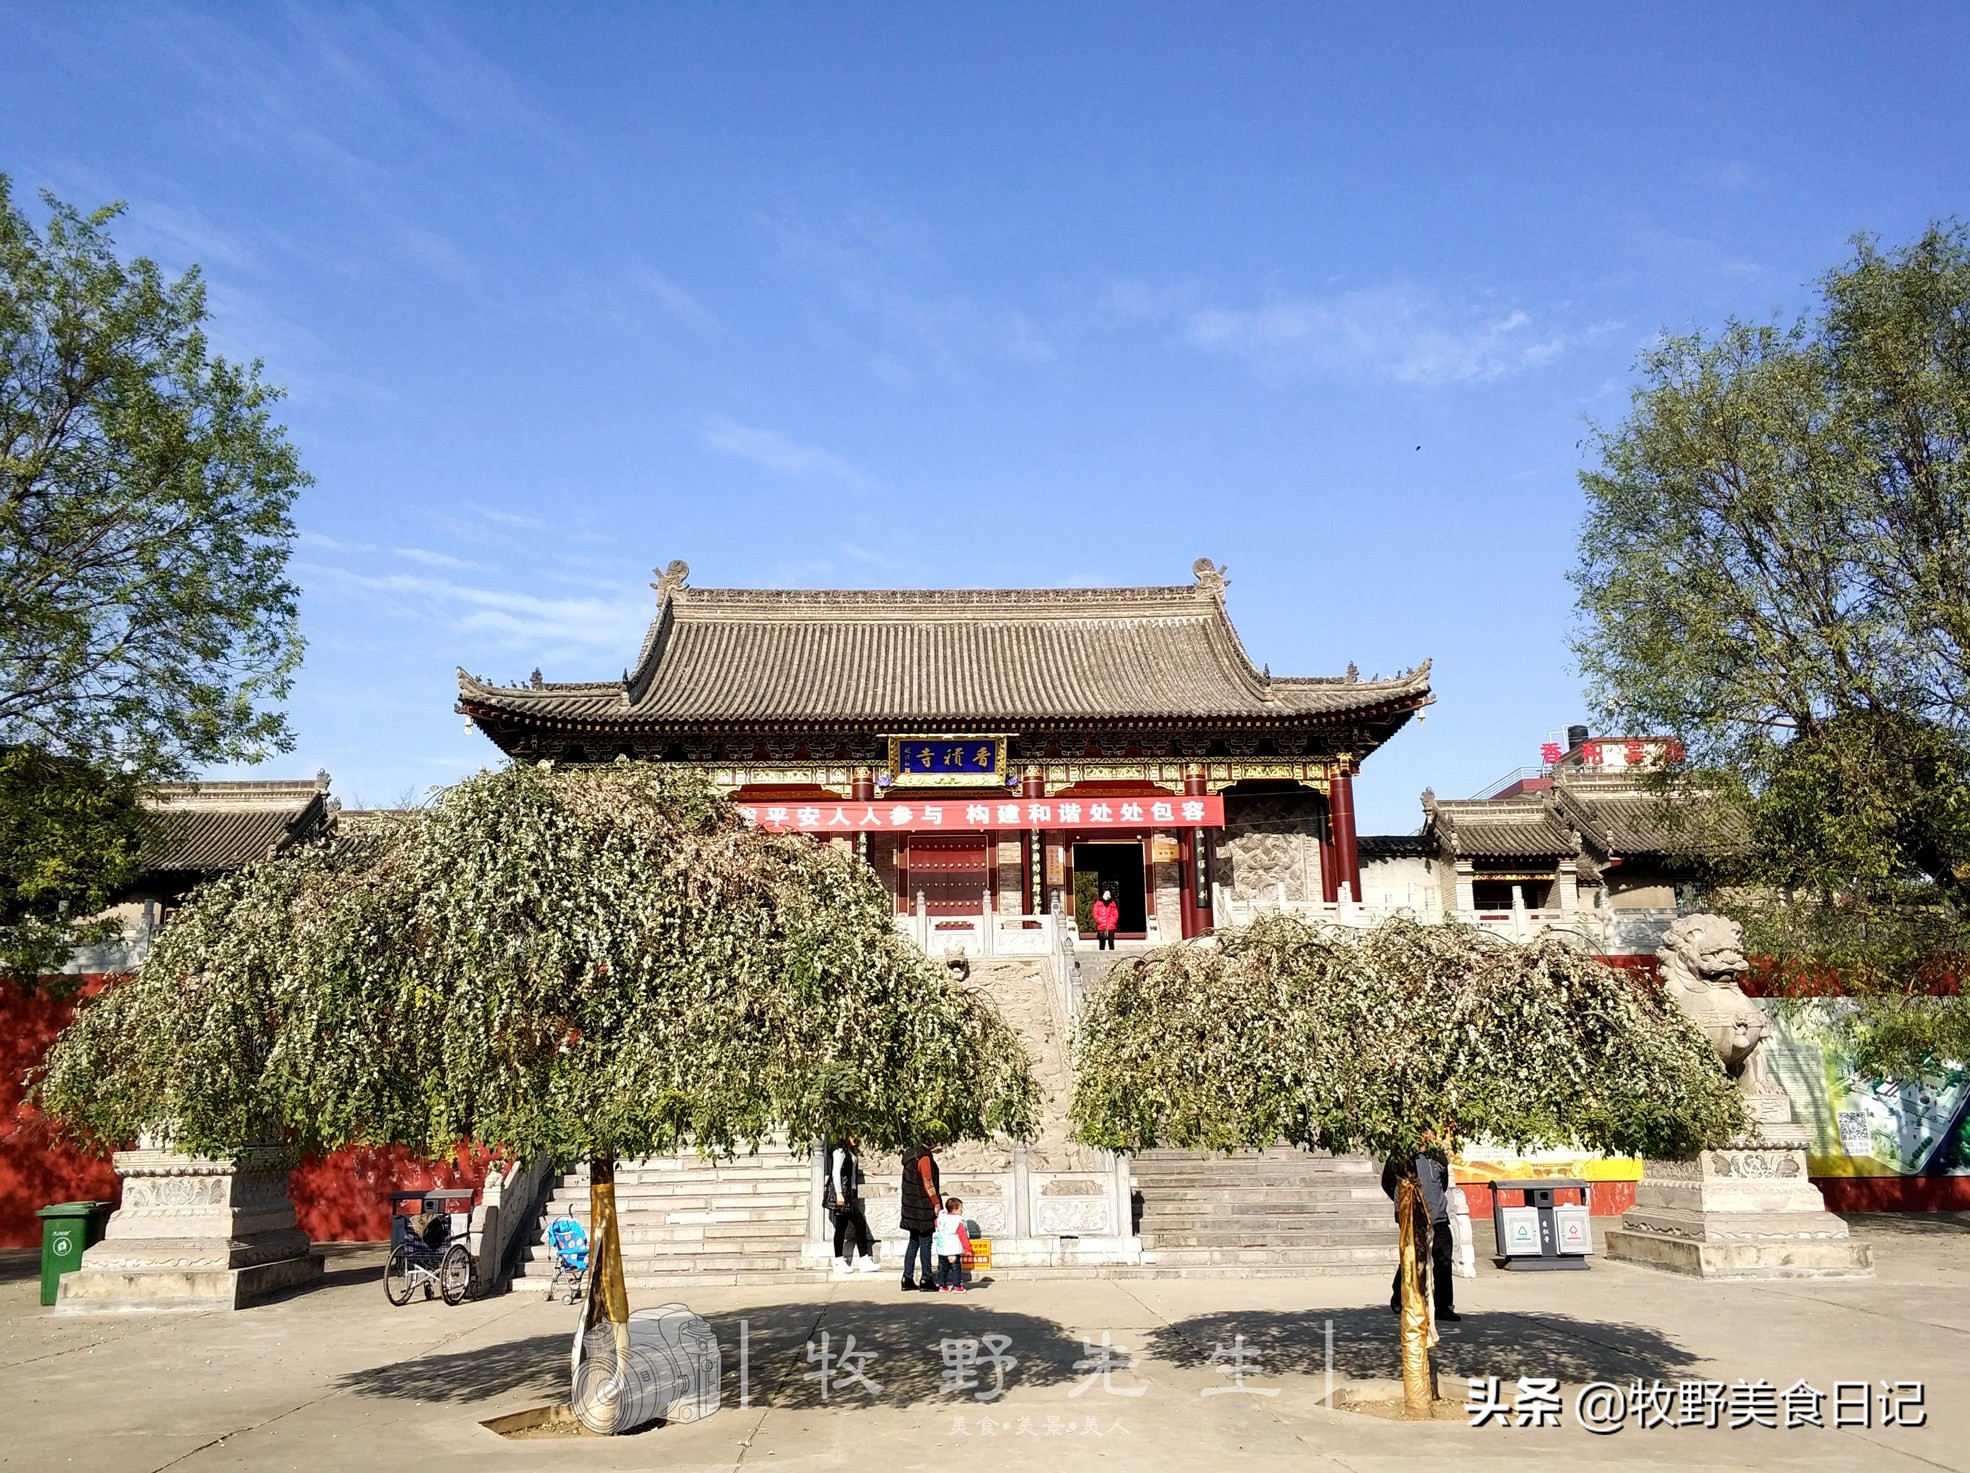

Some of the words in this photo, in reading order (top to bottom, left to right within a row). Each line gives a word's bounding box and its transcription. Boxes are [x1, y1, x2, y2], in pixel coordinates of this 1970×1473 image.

[965, 800, 1206, 824] 构建和谐处处包容
